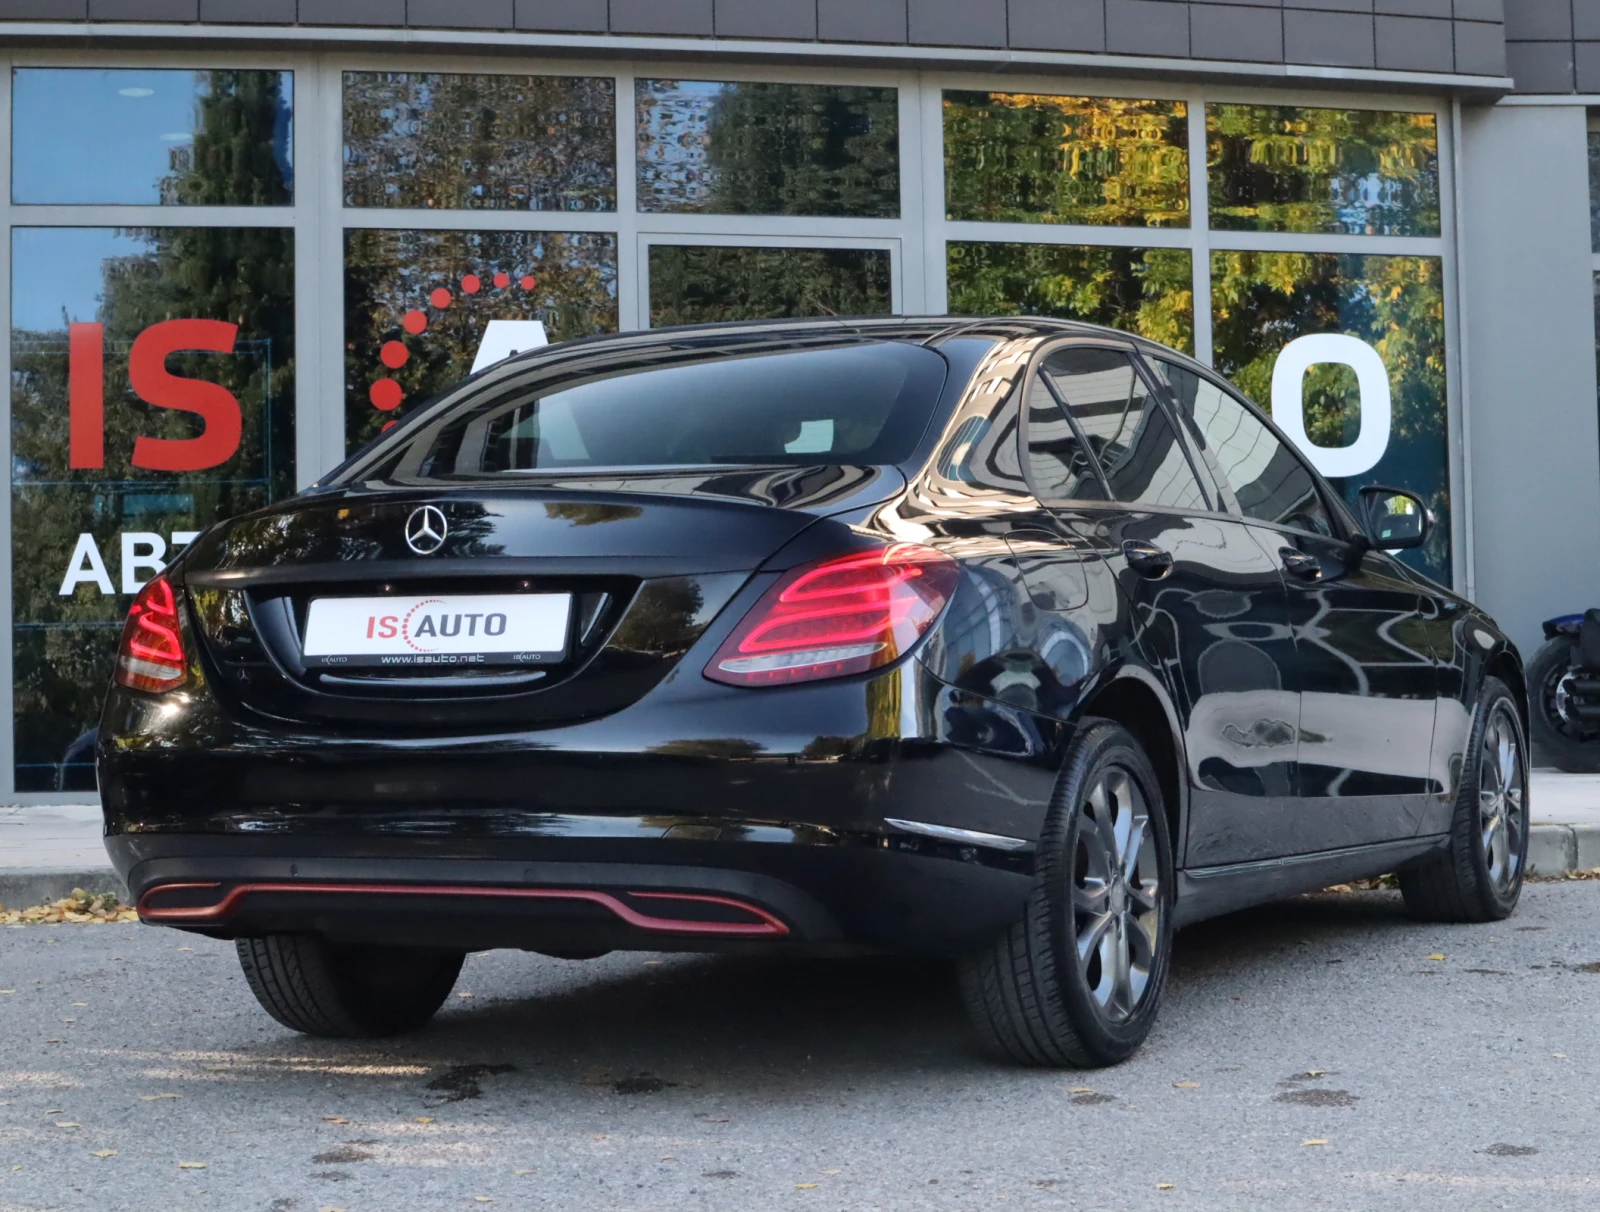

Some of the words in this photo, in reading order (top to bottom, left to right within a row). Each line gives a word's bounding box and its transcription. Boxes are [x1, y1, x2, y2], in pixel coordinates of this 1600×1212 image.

[69, 318, 242, 471] IS
[366, 615, 399, 639] IS
[414, 612, 508, 638] AUTO
[381, 653, 485, 664] www.isauto.net
